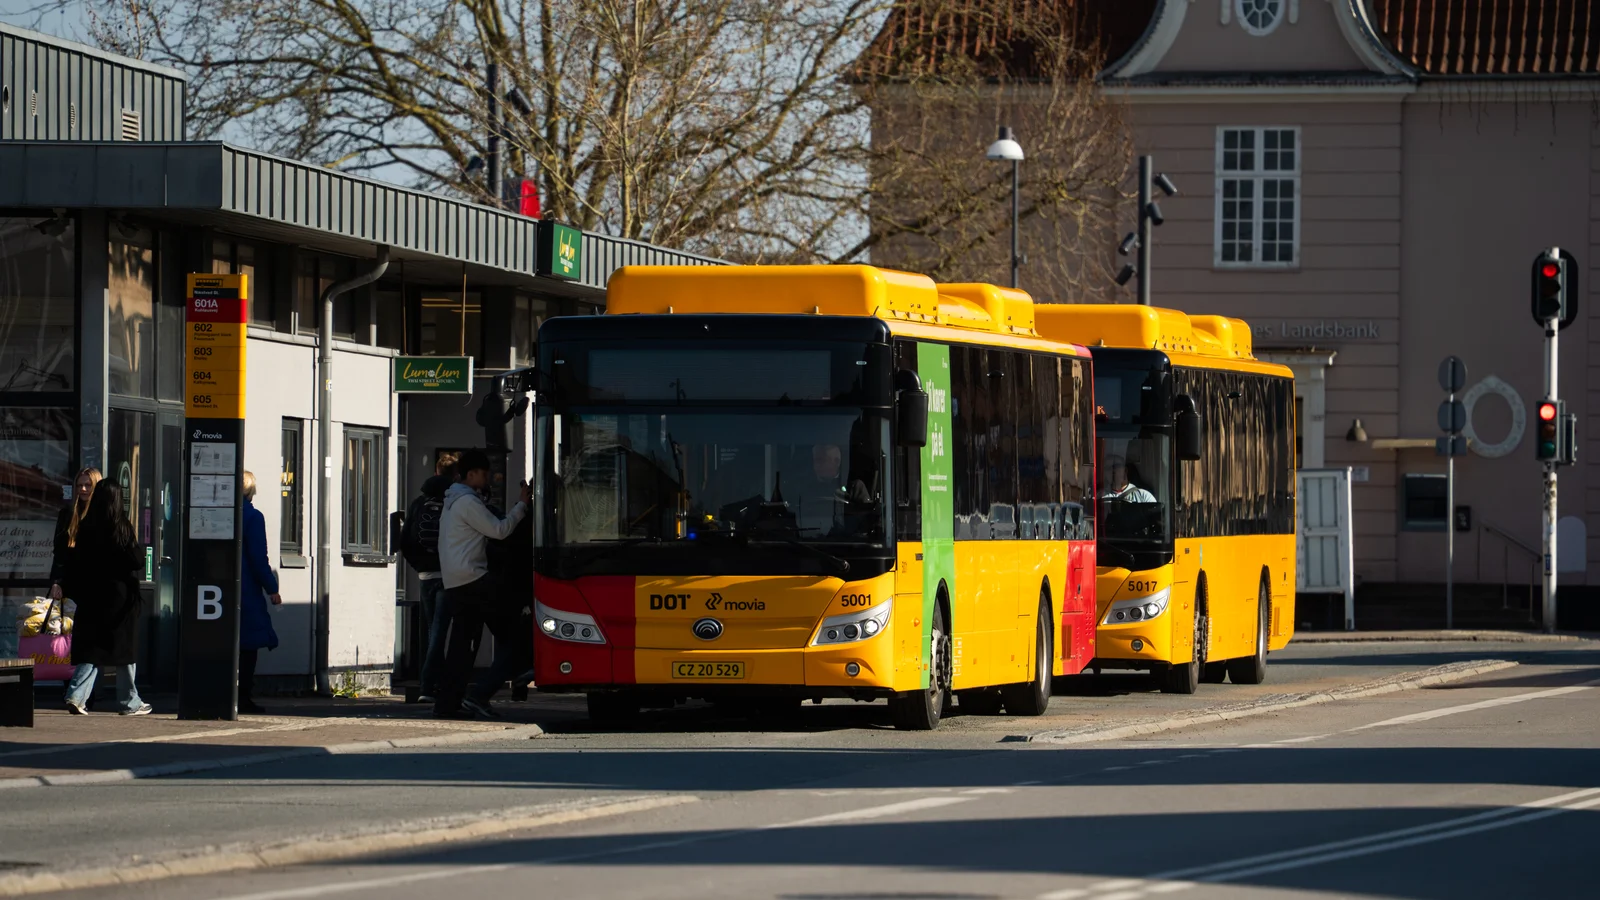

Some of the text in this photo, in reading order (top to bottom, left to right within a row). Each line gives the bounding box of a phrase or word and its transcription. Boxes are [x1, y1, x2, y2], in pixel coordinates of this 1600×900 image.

[195, 299, 218, 308] 601A
[194, 323, 212, 332] 602
[1281, 320, 1379, 338] Landsbank
[194, 347, 212, 356] 603
[193, 371, 211, 380] 604
[403, 362, 460, 379] Lum Lum
[193, 395, 211, 403] 605
[202, 432, 222, 440] movia
[10, 527, 35, 536] dine
[8, 539, 22, 549] og
[1127, 580, 1158, 592] 5017
[197, 585, 223, 620] B
[649, 593, 766, 611] DOT movia
[841, 593, 873, 608] 5001
[677, 664, 740, 677] CZ 20 529
